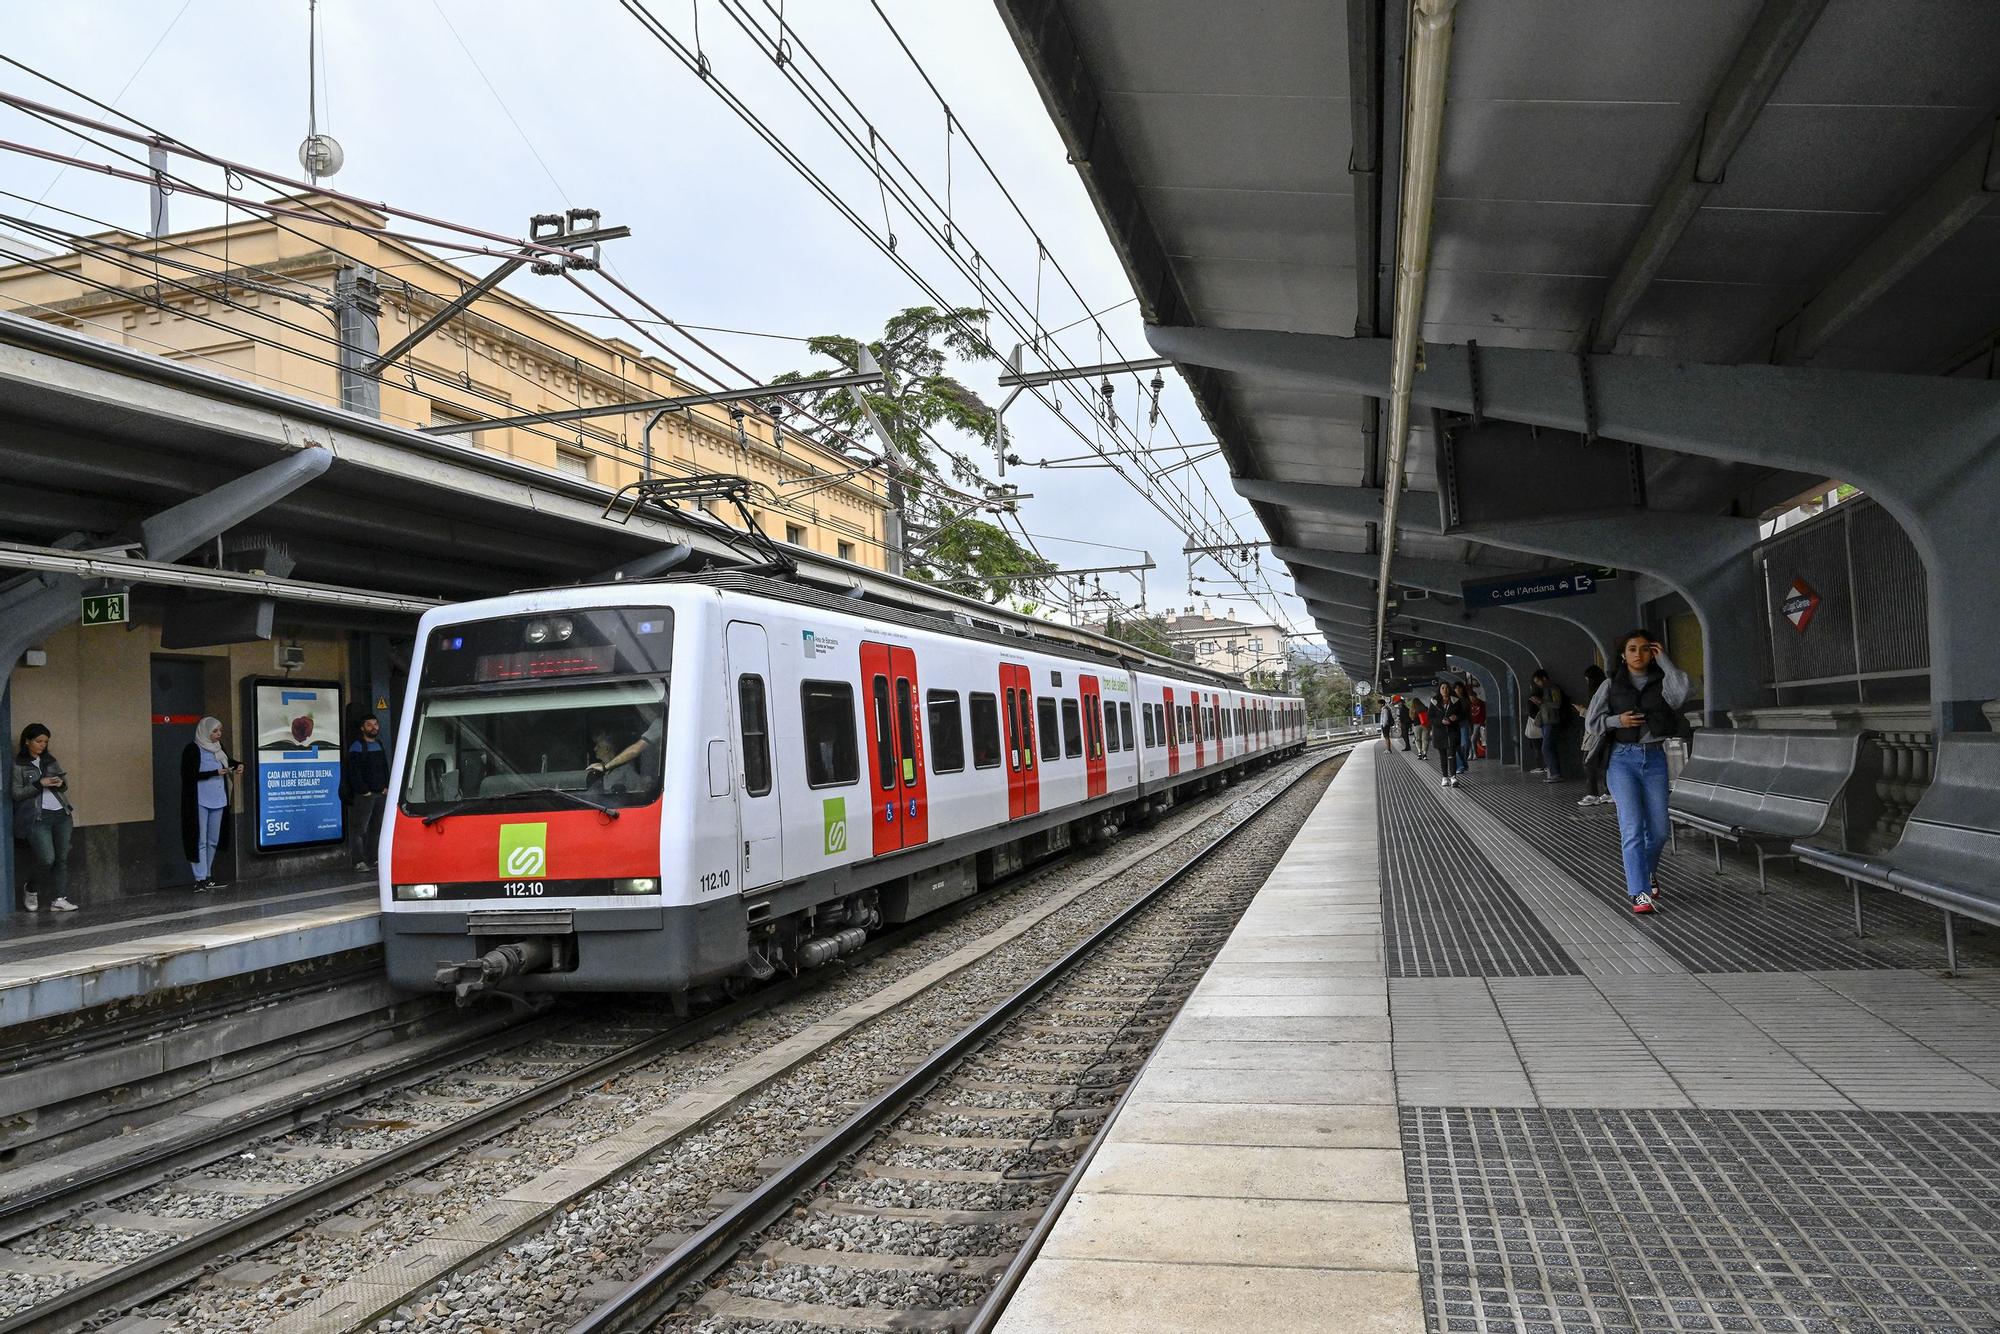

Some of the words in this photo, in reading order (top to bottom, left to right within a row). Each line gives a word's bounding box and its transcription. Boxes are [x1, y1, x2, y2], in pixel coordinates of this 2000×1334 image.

[1492, 590, 1502, 598] C.
[1504, 588, 1516, 596] de
[1518, 584, 1554, 594] l'Andana
[281, 770, 291, 778] ANY
[291, 770, 297, 778] EL
[298, 770, 315, 778] MATEIX
[268, 780, 280, 788] QUIN
[281, 779, 297, 787] LLIBRE
[700, 869, 730, 892] 112.10
[503, 882, 544, 896] 112.10
